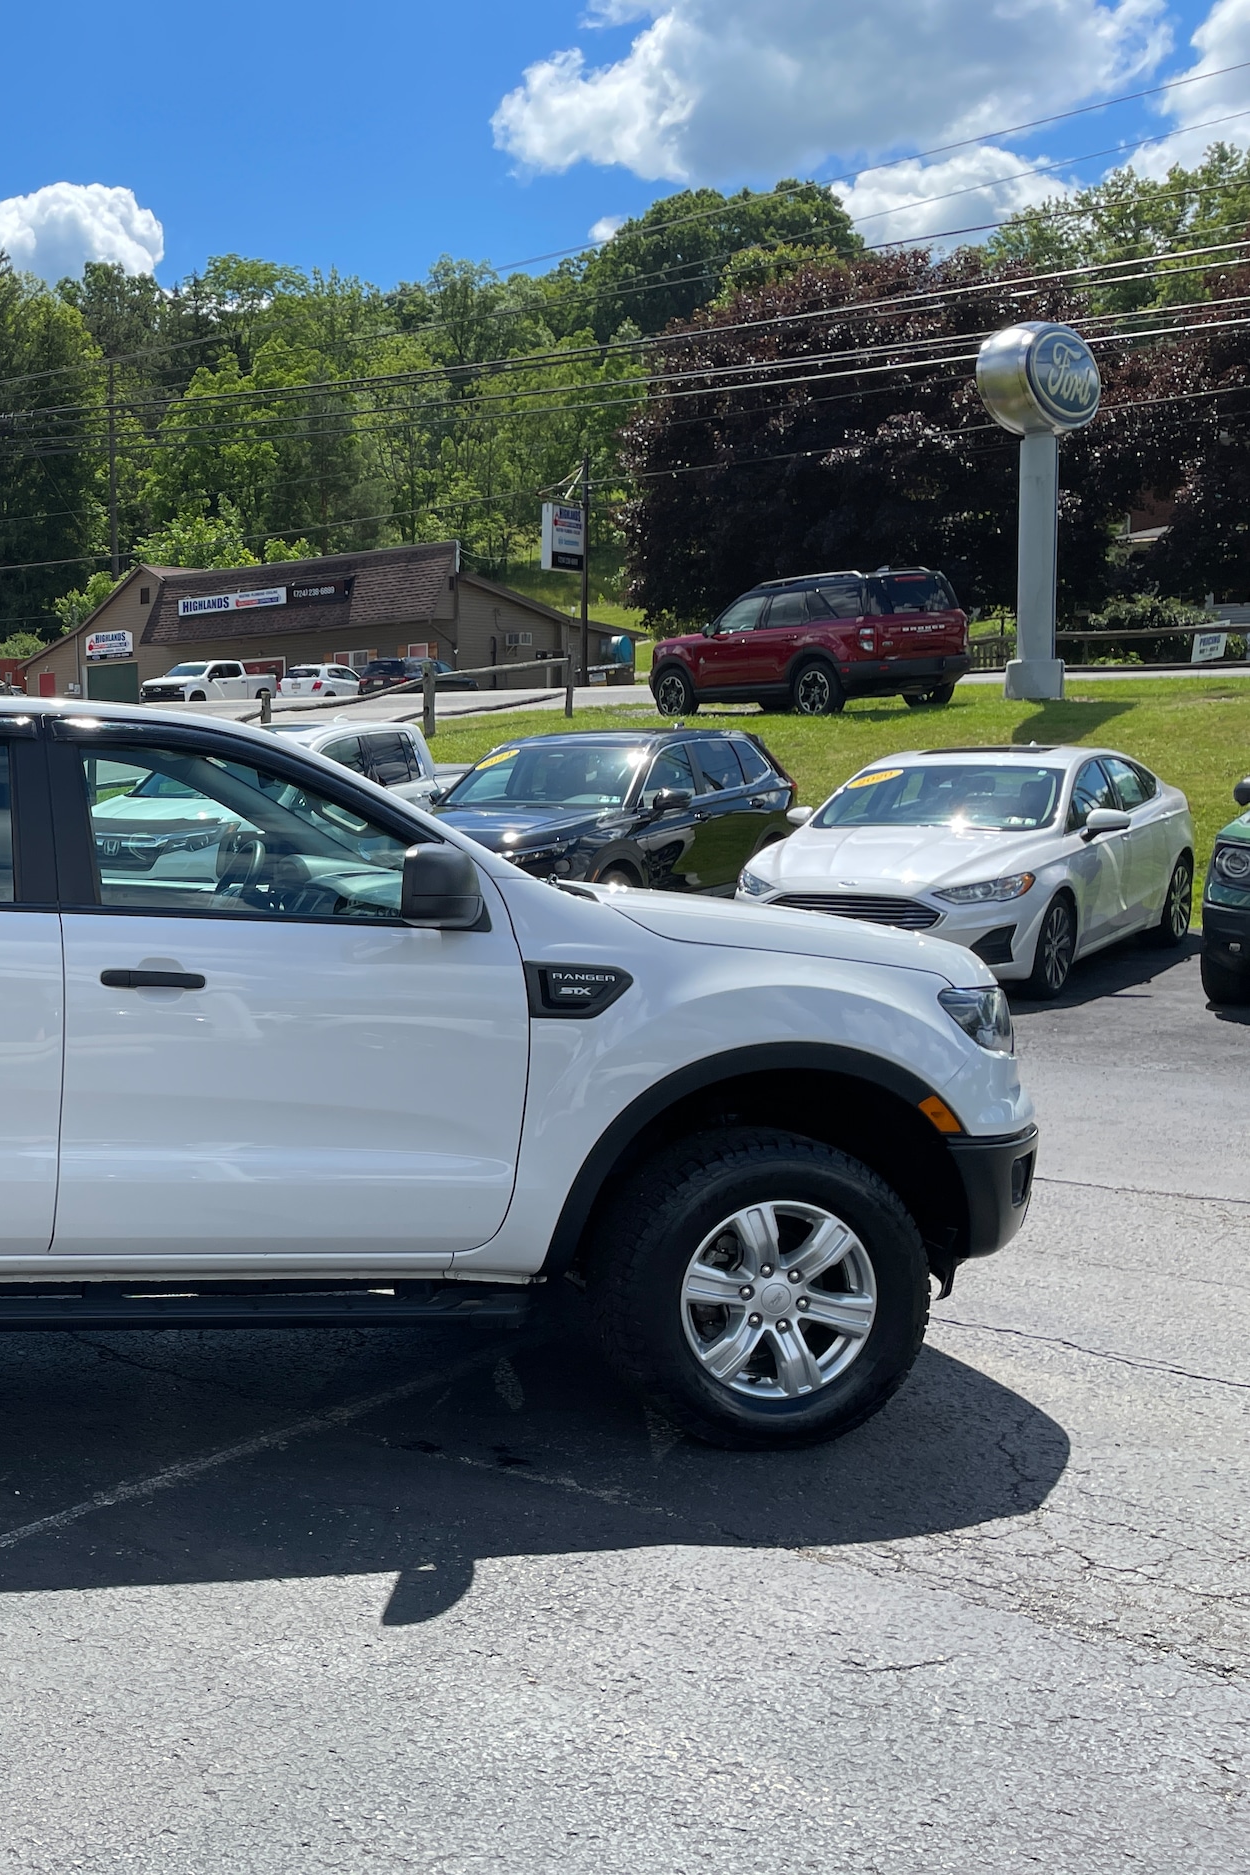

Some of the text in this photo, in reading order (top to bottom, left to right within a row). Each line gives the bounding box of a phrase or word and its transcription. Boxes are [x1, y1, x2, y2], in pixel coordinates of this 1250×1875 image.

[1047, 342, 1091, 406] Ford
[182, 596, 230, 614] HIGHLANDS
[95, 632, 126, 643] HIGHLANDS
[552, 972, 616, 982] RANGER
[559, 986, 592, 996] STX
